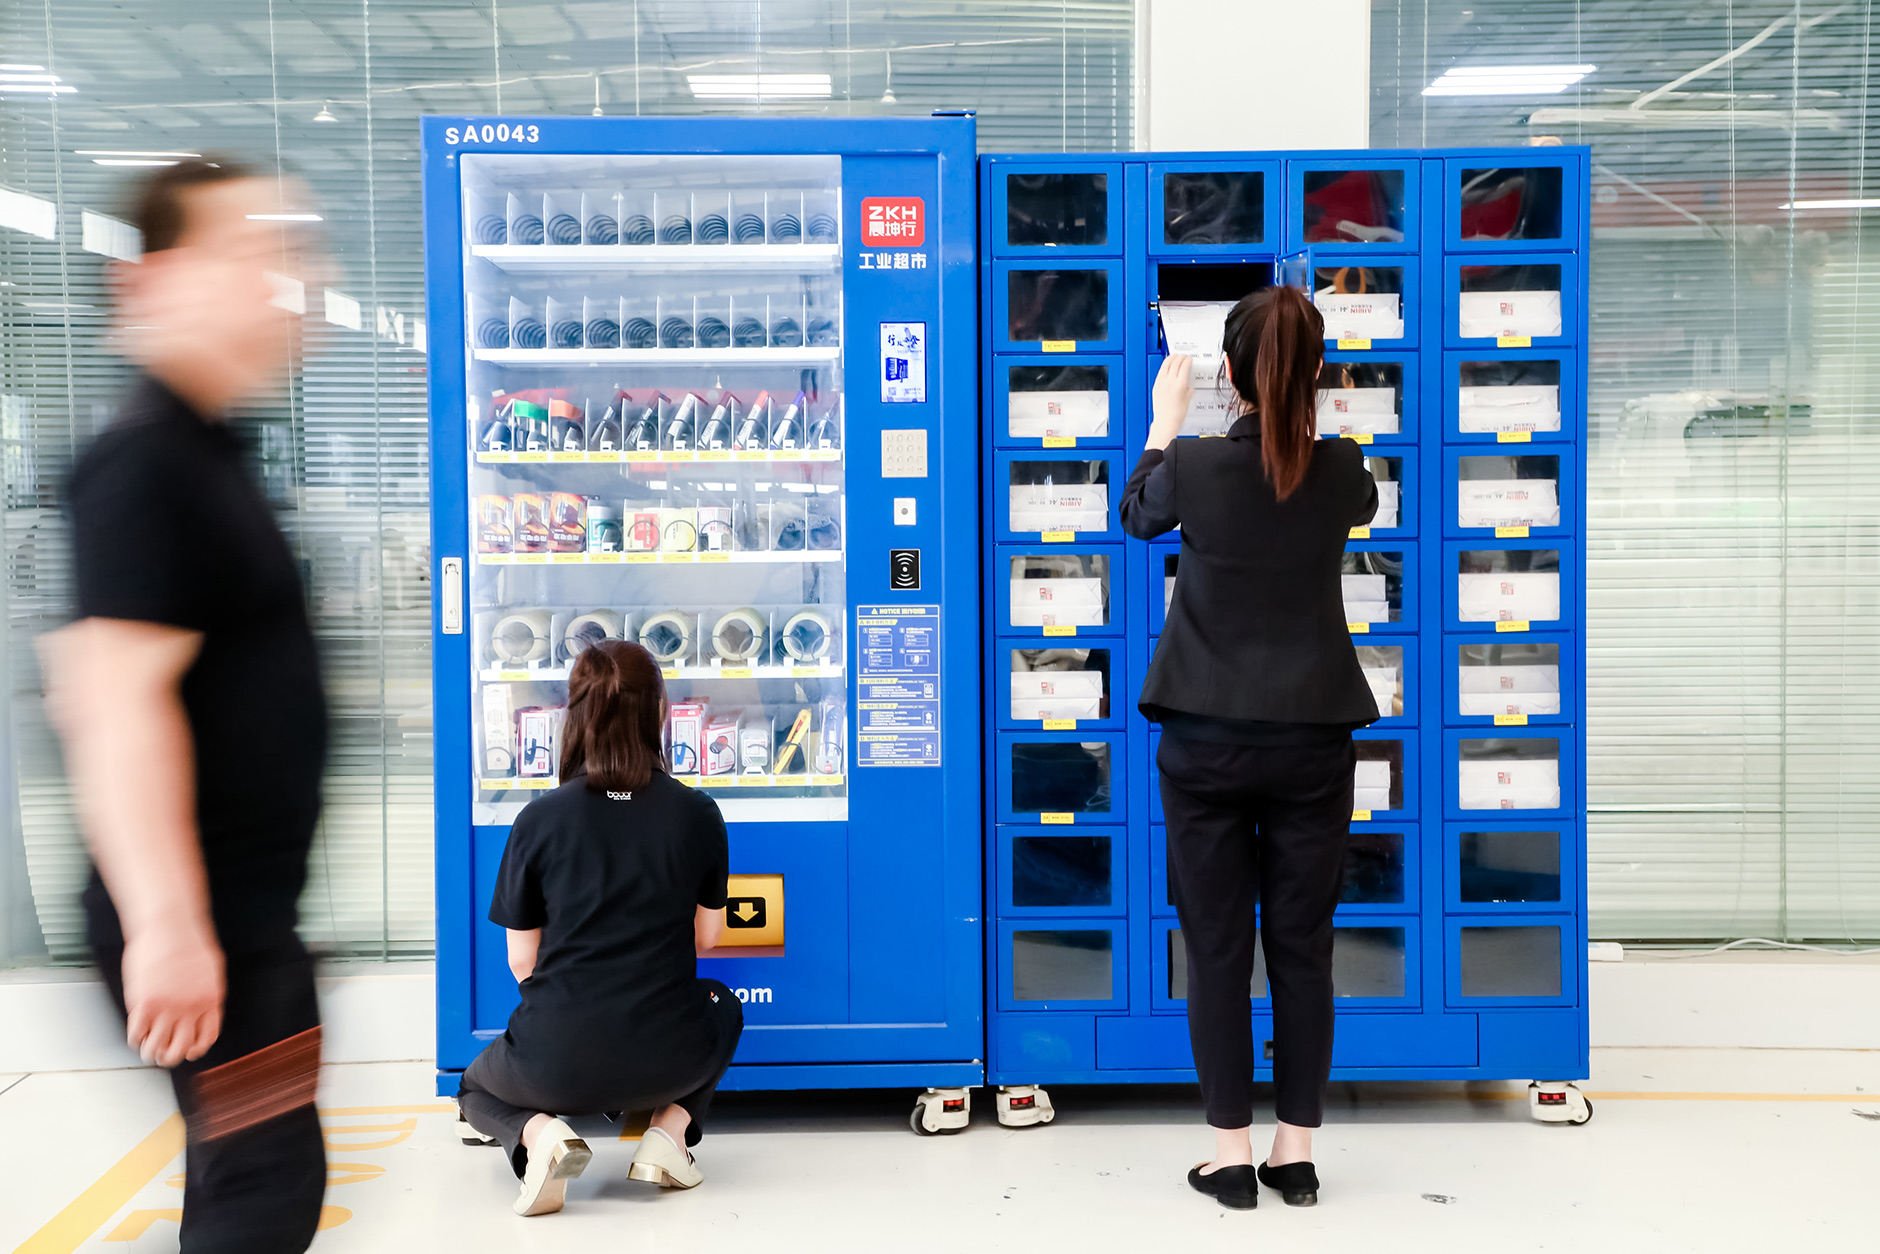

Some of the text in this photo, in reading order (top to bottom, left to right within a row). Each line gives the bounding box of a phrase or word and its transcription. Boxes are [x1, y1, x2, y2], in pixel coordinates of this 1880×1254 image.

[445, 123, 540, 145] SA0043
[868, 206, 917, 220] ZKH
[859, 252, 927, 269] 工业超市
[729, 987, 773, 1004] om
